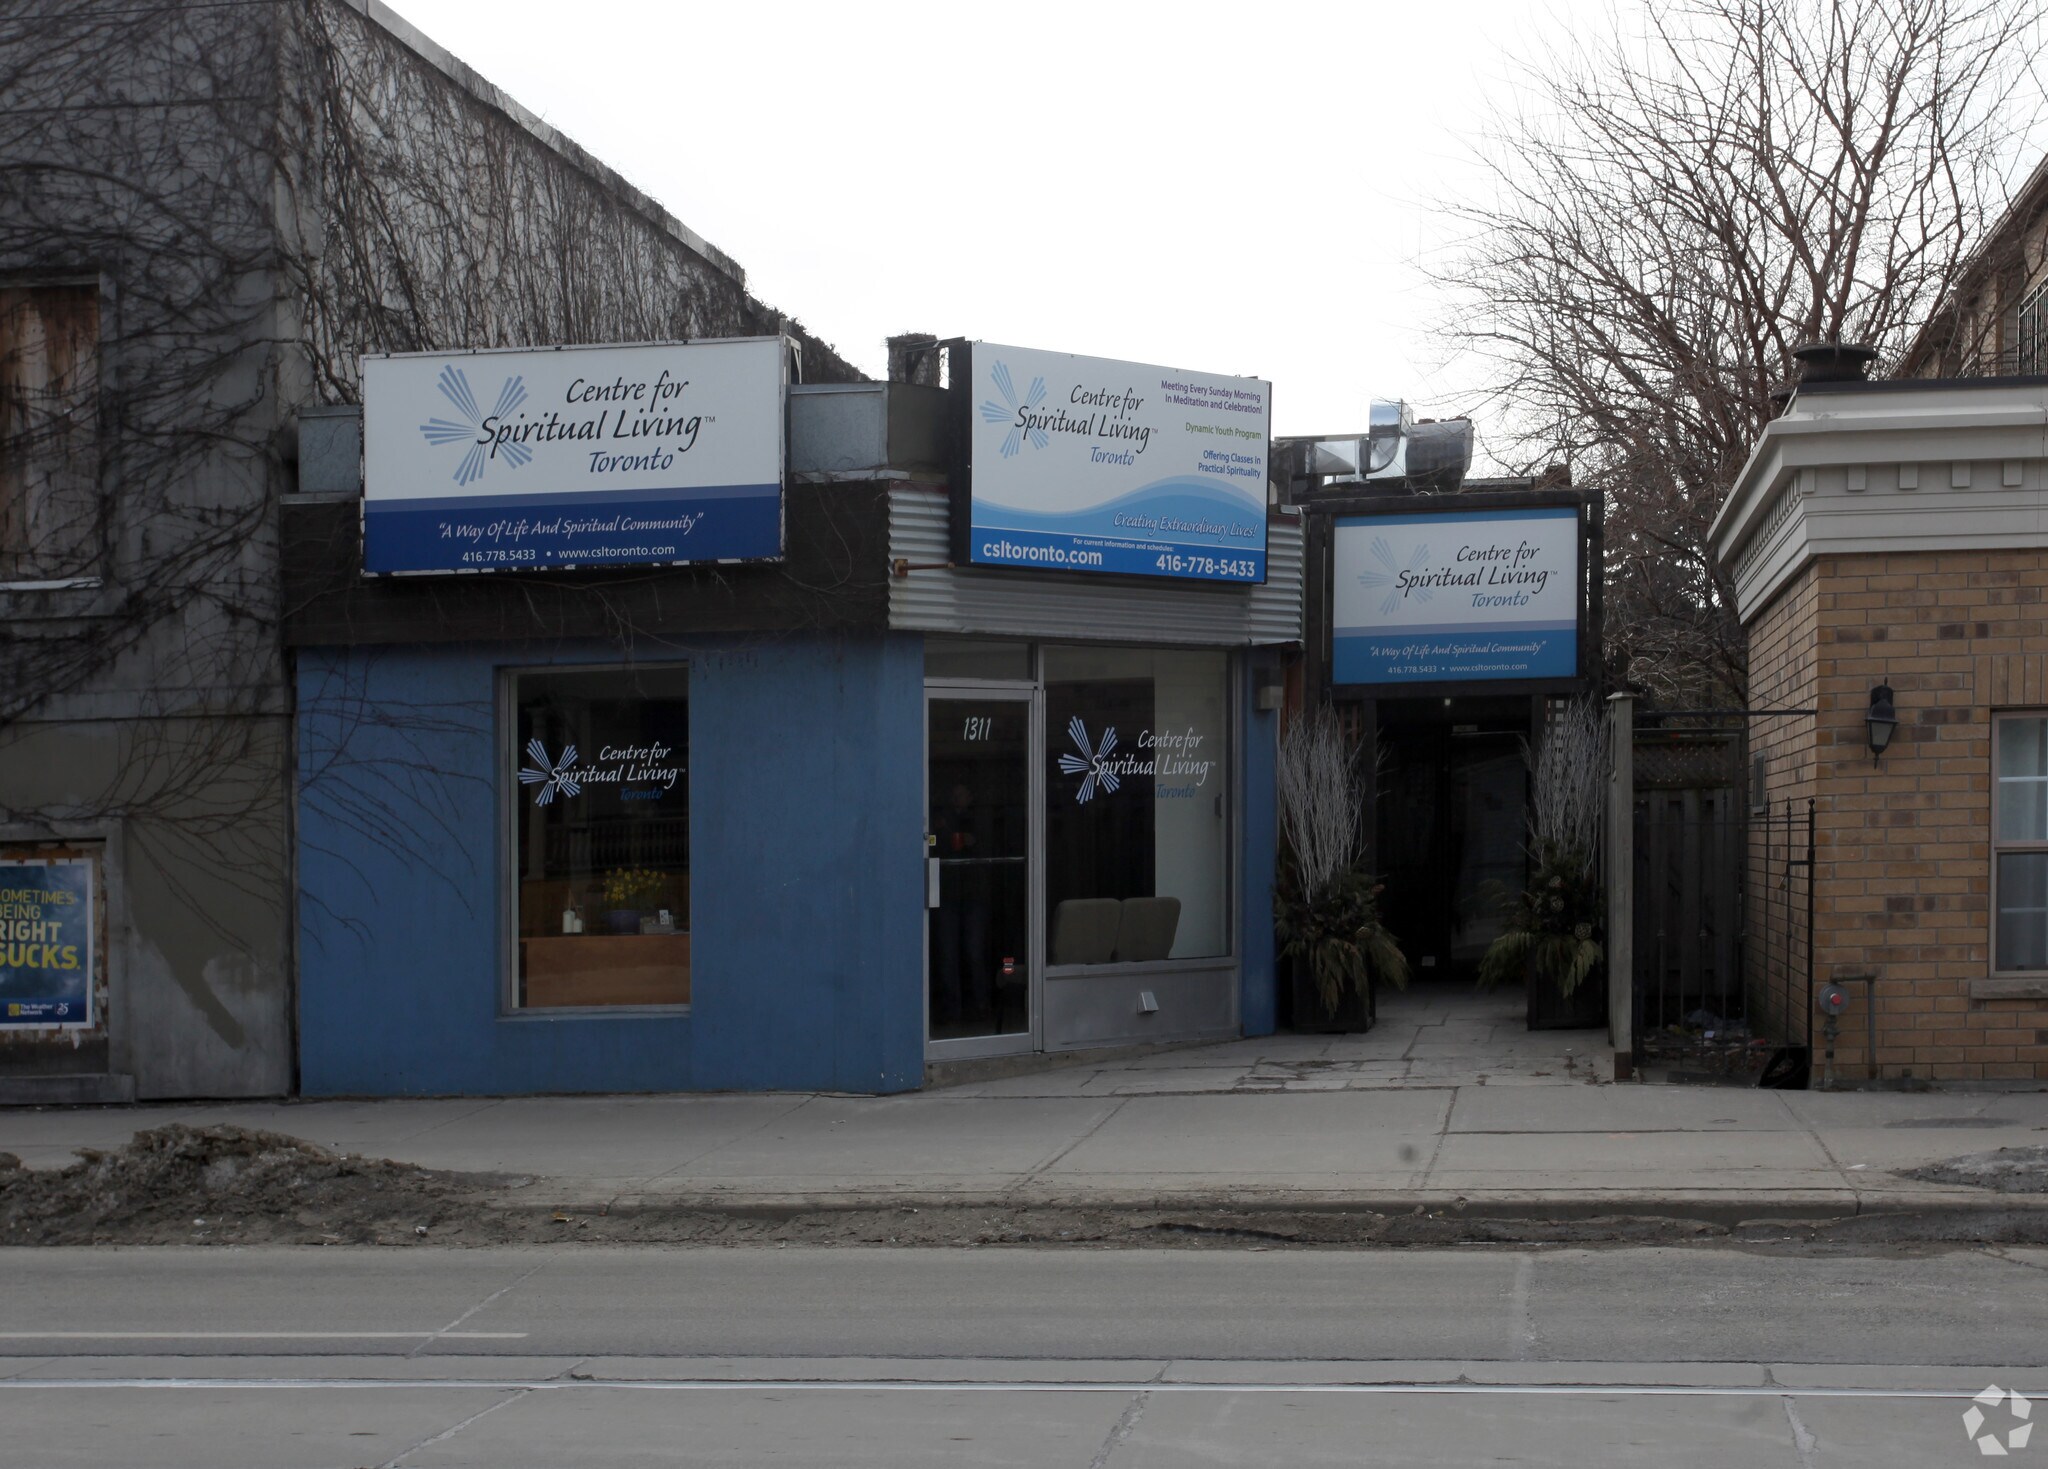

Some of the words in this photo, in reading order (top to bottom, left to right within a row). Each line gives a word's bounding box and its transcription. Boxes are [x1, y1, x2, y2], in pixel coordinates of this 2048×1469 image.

[566, 377, 646, 404] Centre
[650, 369, 690, 412] for
[1070, 384, 1120, 408] Centre
[1120, 387, 1144, 419] for
[1161, 380, 1188, 394] Meeting
[1190, 384, 1208, 396] Every
[1209, 386, 1233, 399] Sunday
[1234, 390, 1261, 403] Morning
[1173, 395, 1209, 407] Meditation
[1210, 400, 1222, 409] and
[1224, 401, 1262, 414] Celebration!
[477, 410, 607, 459] Spiritual
[614, 407, 702, 452] Living
[1015, 405, 1096, 440] Spiritual
[1098, 415, 1151, 453] Living
[1186, 422, 1214, 434] Dynamic
[1215, 426, 1233, 436] Youth
[1235, 428, 1261, 440] Program
[589, 446, 674, 473] Toronto
[1091, 446, 1135, 466] Toronto
[1203, 450, 1230, 463] Offering
[1231, 453, 1253, 464] Classes
[1198, 462, 1225, 474] Practical
[1226, 465, 1261, 479] Spirituality
[456, 525, 484, 543] Way
[487, 521, 506, 543] Of
[506, 519, 529, 542] Life
[531, 518, 560, 536] And
[562, 515, 620, 539] Spiritual
[1113, 512, 1158, 536] Creating
[1159, 516, 1228, 542] Extraordinary
[1229, 523, 1258, 538] Lives!
[463, 550, 536, 562] 416.778.5433
[558, 545, 675, 560] www.csltoronto.com
[983, 540, 1103, 566] csltoronto.com
[1457, 545, 1511, 563] Centre
[1513, 540, 1541, 568] for
[1156, 554, 1256, 577] 416-778-5433
[1396, 567, 1485, 598] Spiritual
[1488, 565, 1549, 594] Living
[1471, 590, 1529, 608] Toronto
[1381, 648, 1400, 660] Way
[1402, 645, 1415, 659] Of
[1414, 645, 1430, 659] Life
[1431, 644, 1452, 655] And
[1452, 642, 1491, 657] Spiritual
[1388, 665, 1437, 674] 416.778.5433
[1450, 663, 1528, 672] www.csltoronto.com
[963, 716, 992, 741] 1311
[599, 745, 648, 761] Centre
[648, 741, 671, 765] for
[1138, 730, 1182, 749] Centre
[1182, 727, 1203, 757] for
[548, 764, 624, 792] Spiritual
[627, 762, 678, 789] Living
[1089, 754, 1160, 786] Spiritual
[1163, 754, 1210, 786] Living
[620, 786, 664, 800] Toronto
[1156, 784, 1196, 799] Toronto
[0, 889, 76, 905] OMETIMES
[0, 904, 41, 920] EING
